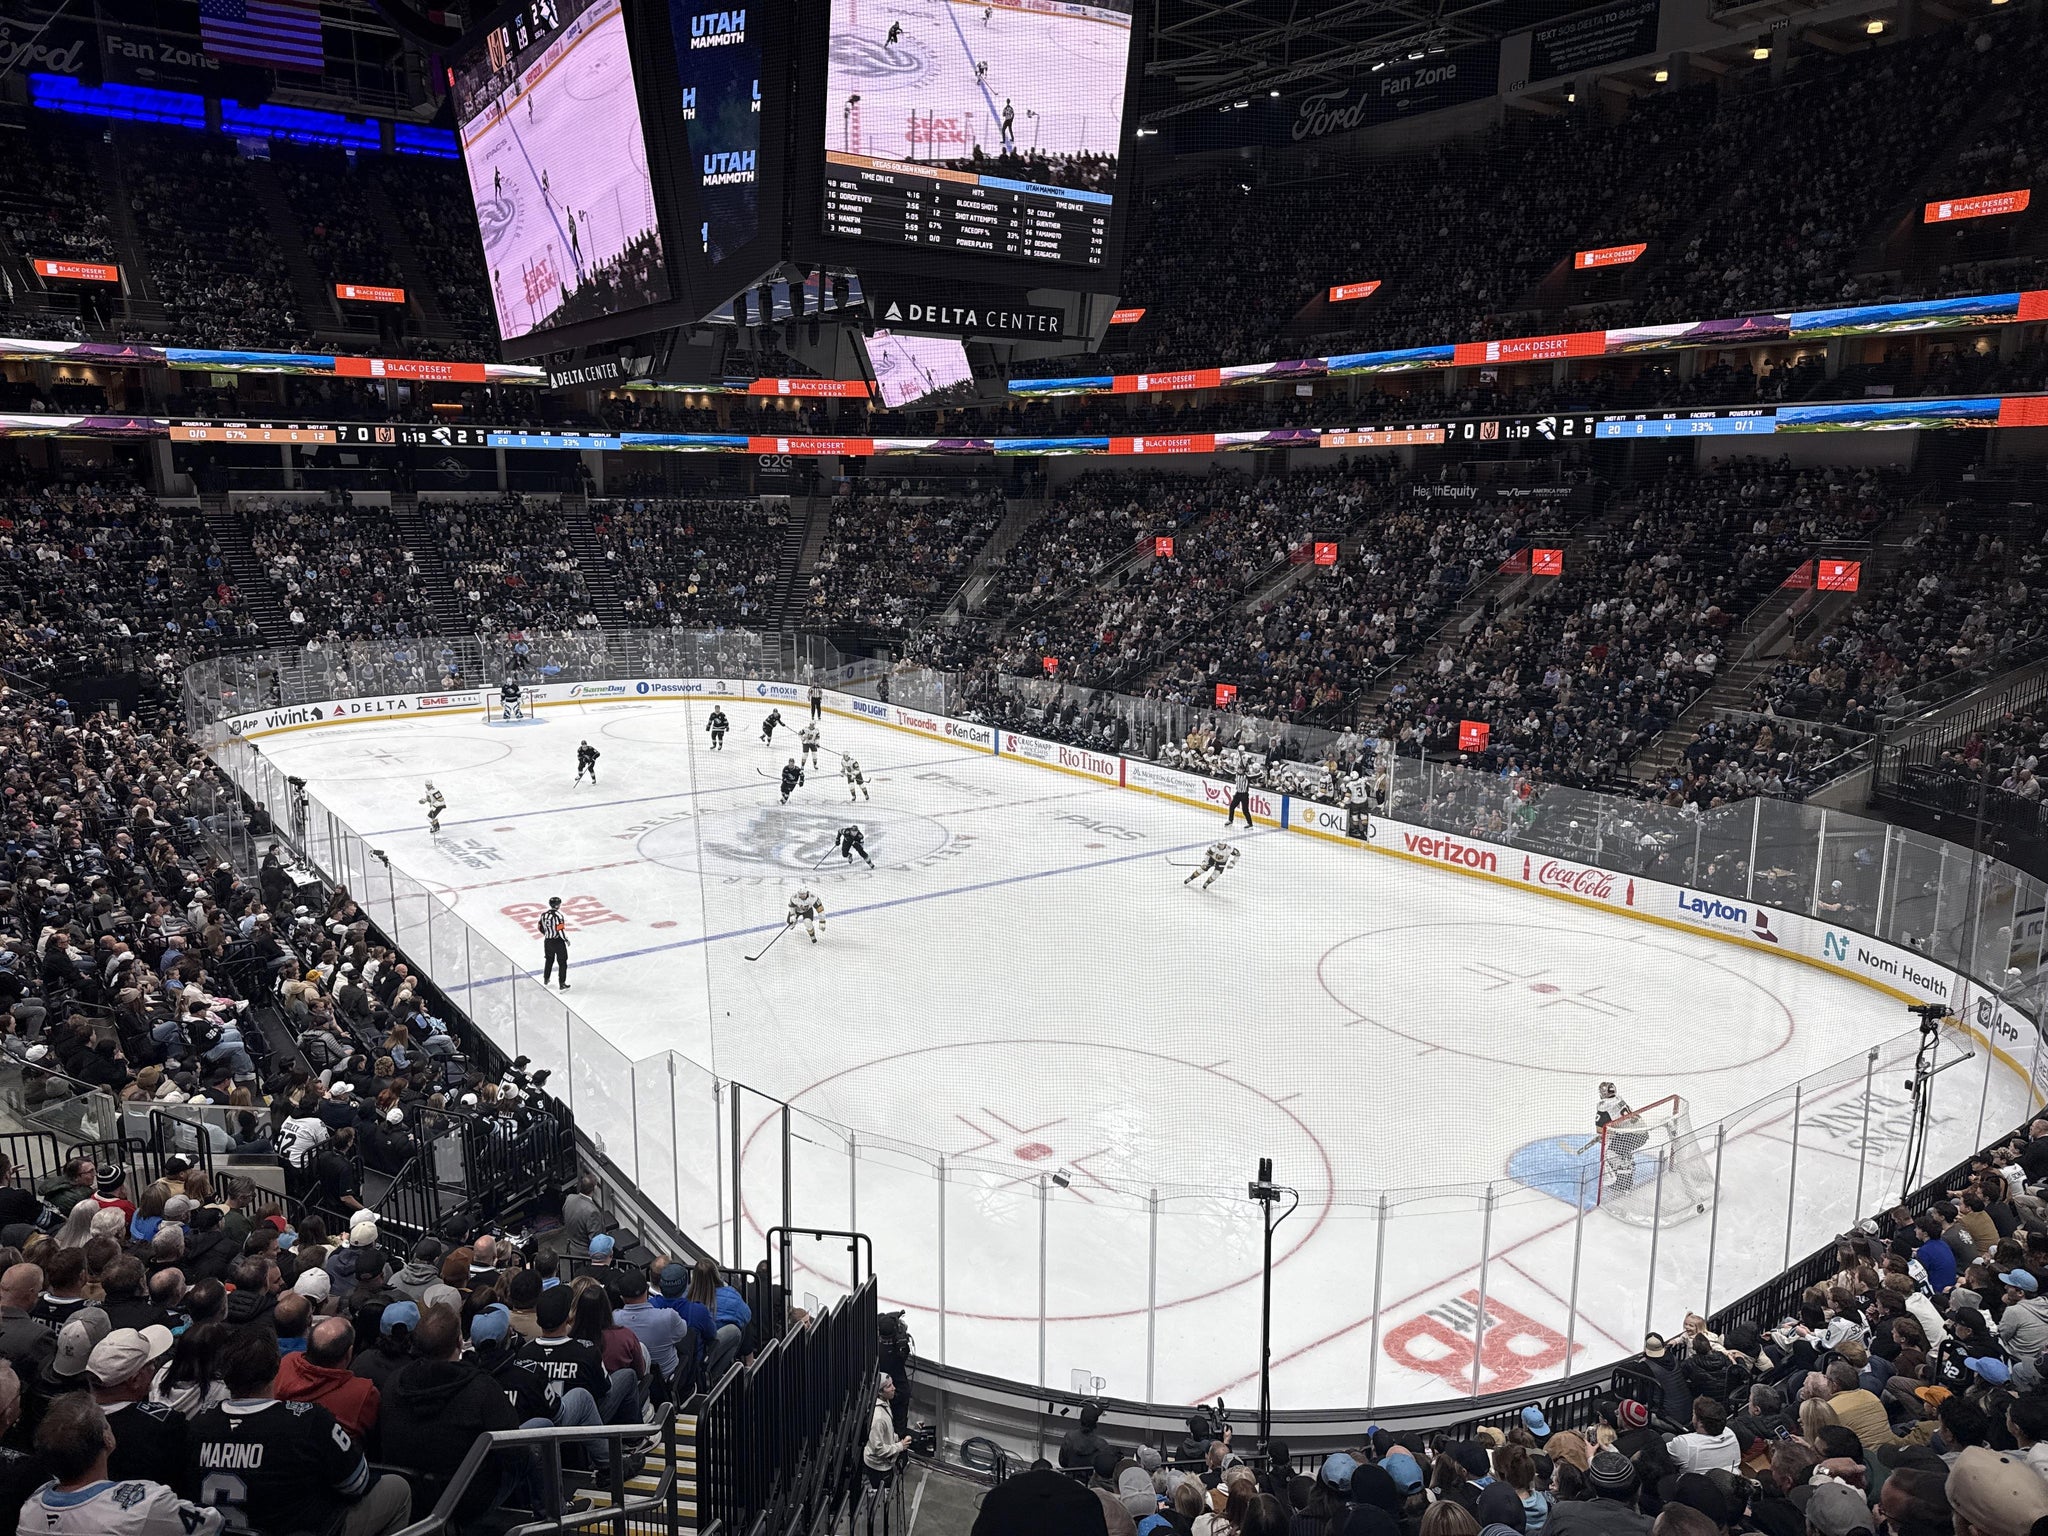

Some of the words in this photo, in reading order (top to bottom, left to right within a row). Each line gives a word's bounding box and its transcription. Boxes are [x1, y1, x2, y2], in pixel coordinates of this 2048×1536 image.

[691, 10, 746, 37] UTAH
[1605, 12, 1617, 23] TO
[690, 31, 745, 50] MAMMOTH
[107, 35, 154, 60] Fan
[160, 44, 220, 70] Zone
[1381, 76, 1411, 97] Fan
[1414, 64, 1457, 88] Zone
[1292, 88, 1368, 141] Ford
[703, 150, 756, 175] UTAH
[872, 160, 891, 169] VEGAS
[892, 163, 914, 173] GOLDEN
[703, 171, 755, 186] MAMMOTH
[861, 172, 875, 181] TIME
[885, 175, 894, 184] ICE
[828, 191, 836, 199] 16
[907, 191, 920, 199] 4:16
[1040, 187, 1065, 196] MAMMOTH
[827, 202, 836, 210] 93
[839, 204, 863, 213] MARNER
[956, 200, 981, 210] BLOCKED
[981, 203, 998, 212] SHOTS
[1056, 202, 1068, 210] TIME
[1954, 202, 1980, 212] BLACK
[1981, 198, 2014, 208] DESERT
[933, 209, 941, 217] 12
[955, 212, 970, 221] SHOT
[970, 214, 998, 224] ATTEMPTS
[928, 222, 942, 230] 67%
[1594, 251, 1613, 260] BLACK
[1614, 249, 1636, 257] DESERT
[908, 303, 978, 326] DELTA
[986, 311, 1058, 333] CENTER
[1502, 341, 1532, 353] BLACK
[1532, 338, 1568, 351] DESERT
[1532, 350, 1568, 359] RESORT
[387, 363, 416, 373] BLACK
[418, 365, 452, 374] DESERT
[557, 368, 585, 388] DELTA
[584, 362, 618, 382] CENTER
[792, 382, 816, 391] BLACK
[817, 383, 846, 391] DESERT
[1150, 376, 1172, 385] BLACK
[1172, 374, 1196, 384] DESERT
[189, 429, 207, 439] 0/0
[225, 430, 247, 440] 67%
[263, 431, 271, 440] 2
[291, 432, 297, 440] 6
[313, 432, 325, 441] 12
[340, 431, 346, 440] 7
[358, 427, 368, 442] 0
[402, 432, 426, 444] 1:19
[458, 431, 467, 443] 2
[477, 435, 484, 443] 8
[498, 437, 508, 445] 20
[543, 438, 549, 446] 4
[563, 439, 580, 447] 33%
[594, 439, 607, 448] 0/1
[1386, 434, 1391, 443] 2
[1425, 432, 1435, 441] 12
[1448, 431, 1454, 439] 7
[1464, 424, 1474, 439] 0
[1506, 426, 1530, 439] 1:19
[1562, 419, 1574, 436] 2
[1585, 424, 1592, 434] 8
[1608, 425, 1620, 435] 20
[1636, 424, 1643, 434] 8
[1665, 423, 1672, 433] 4
[1691, 422, 1713, 432] 33%
[1734, 421, 1753, 431] 0/1
[791, 441, 816, 449] BLACK
[1145, 440, 1167, 448] BLACK
[1168, 439, 1192, 447] DESERT
[758, 454, 793, 469] G2G
[1413, 485, 1477, 499] HealthEquity
[583, 685, 626, 694] SameDay
[652, 683, 702, 692] 1Password
[770, 686, 798, 695] moxie
[351, 699, 408, 714] DELTA
[422, 697, 449, 706] SME
[853, 700, 867, 713] BUD
[868, 704, 887, 718] LIGHT
[902, 712, 938, 731] Trucordia
[952, 723, 969, 739] Ken
[969, 727, 990, 744] Garff
[1356, 786, 1363, 798] 3
[1404, 832, 1497, 873] verizon
[1539, 860, 1617, 899] Coca-Cola
[562, 895, 630, 931] SEAT
[1679, 891, 1747, 923] Layton
[1858, 948, 1898, 976] Nomi
[1902, 967, 1947, 998] Health
[331, 1423, 351, 1452] 6
[200, 1443, 264, 1469] MARINO
